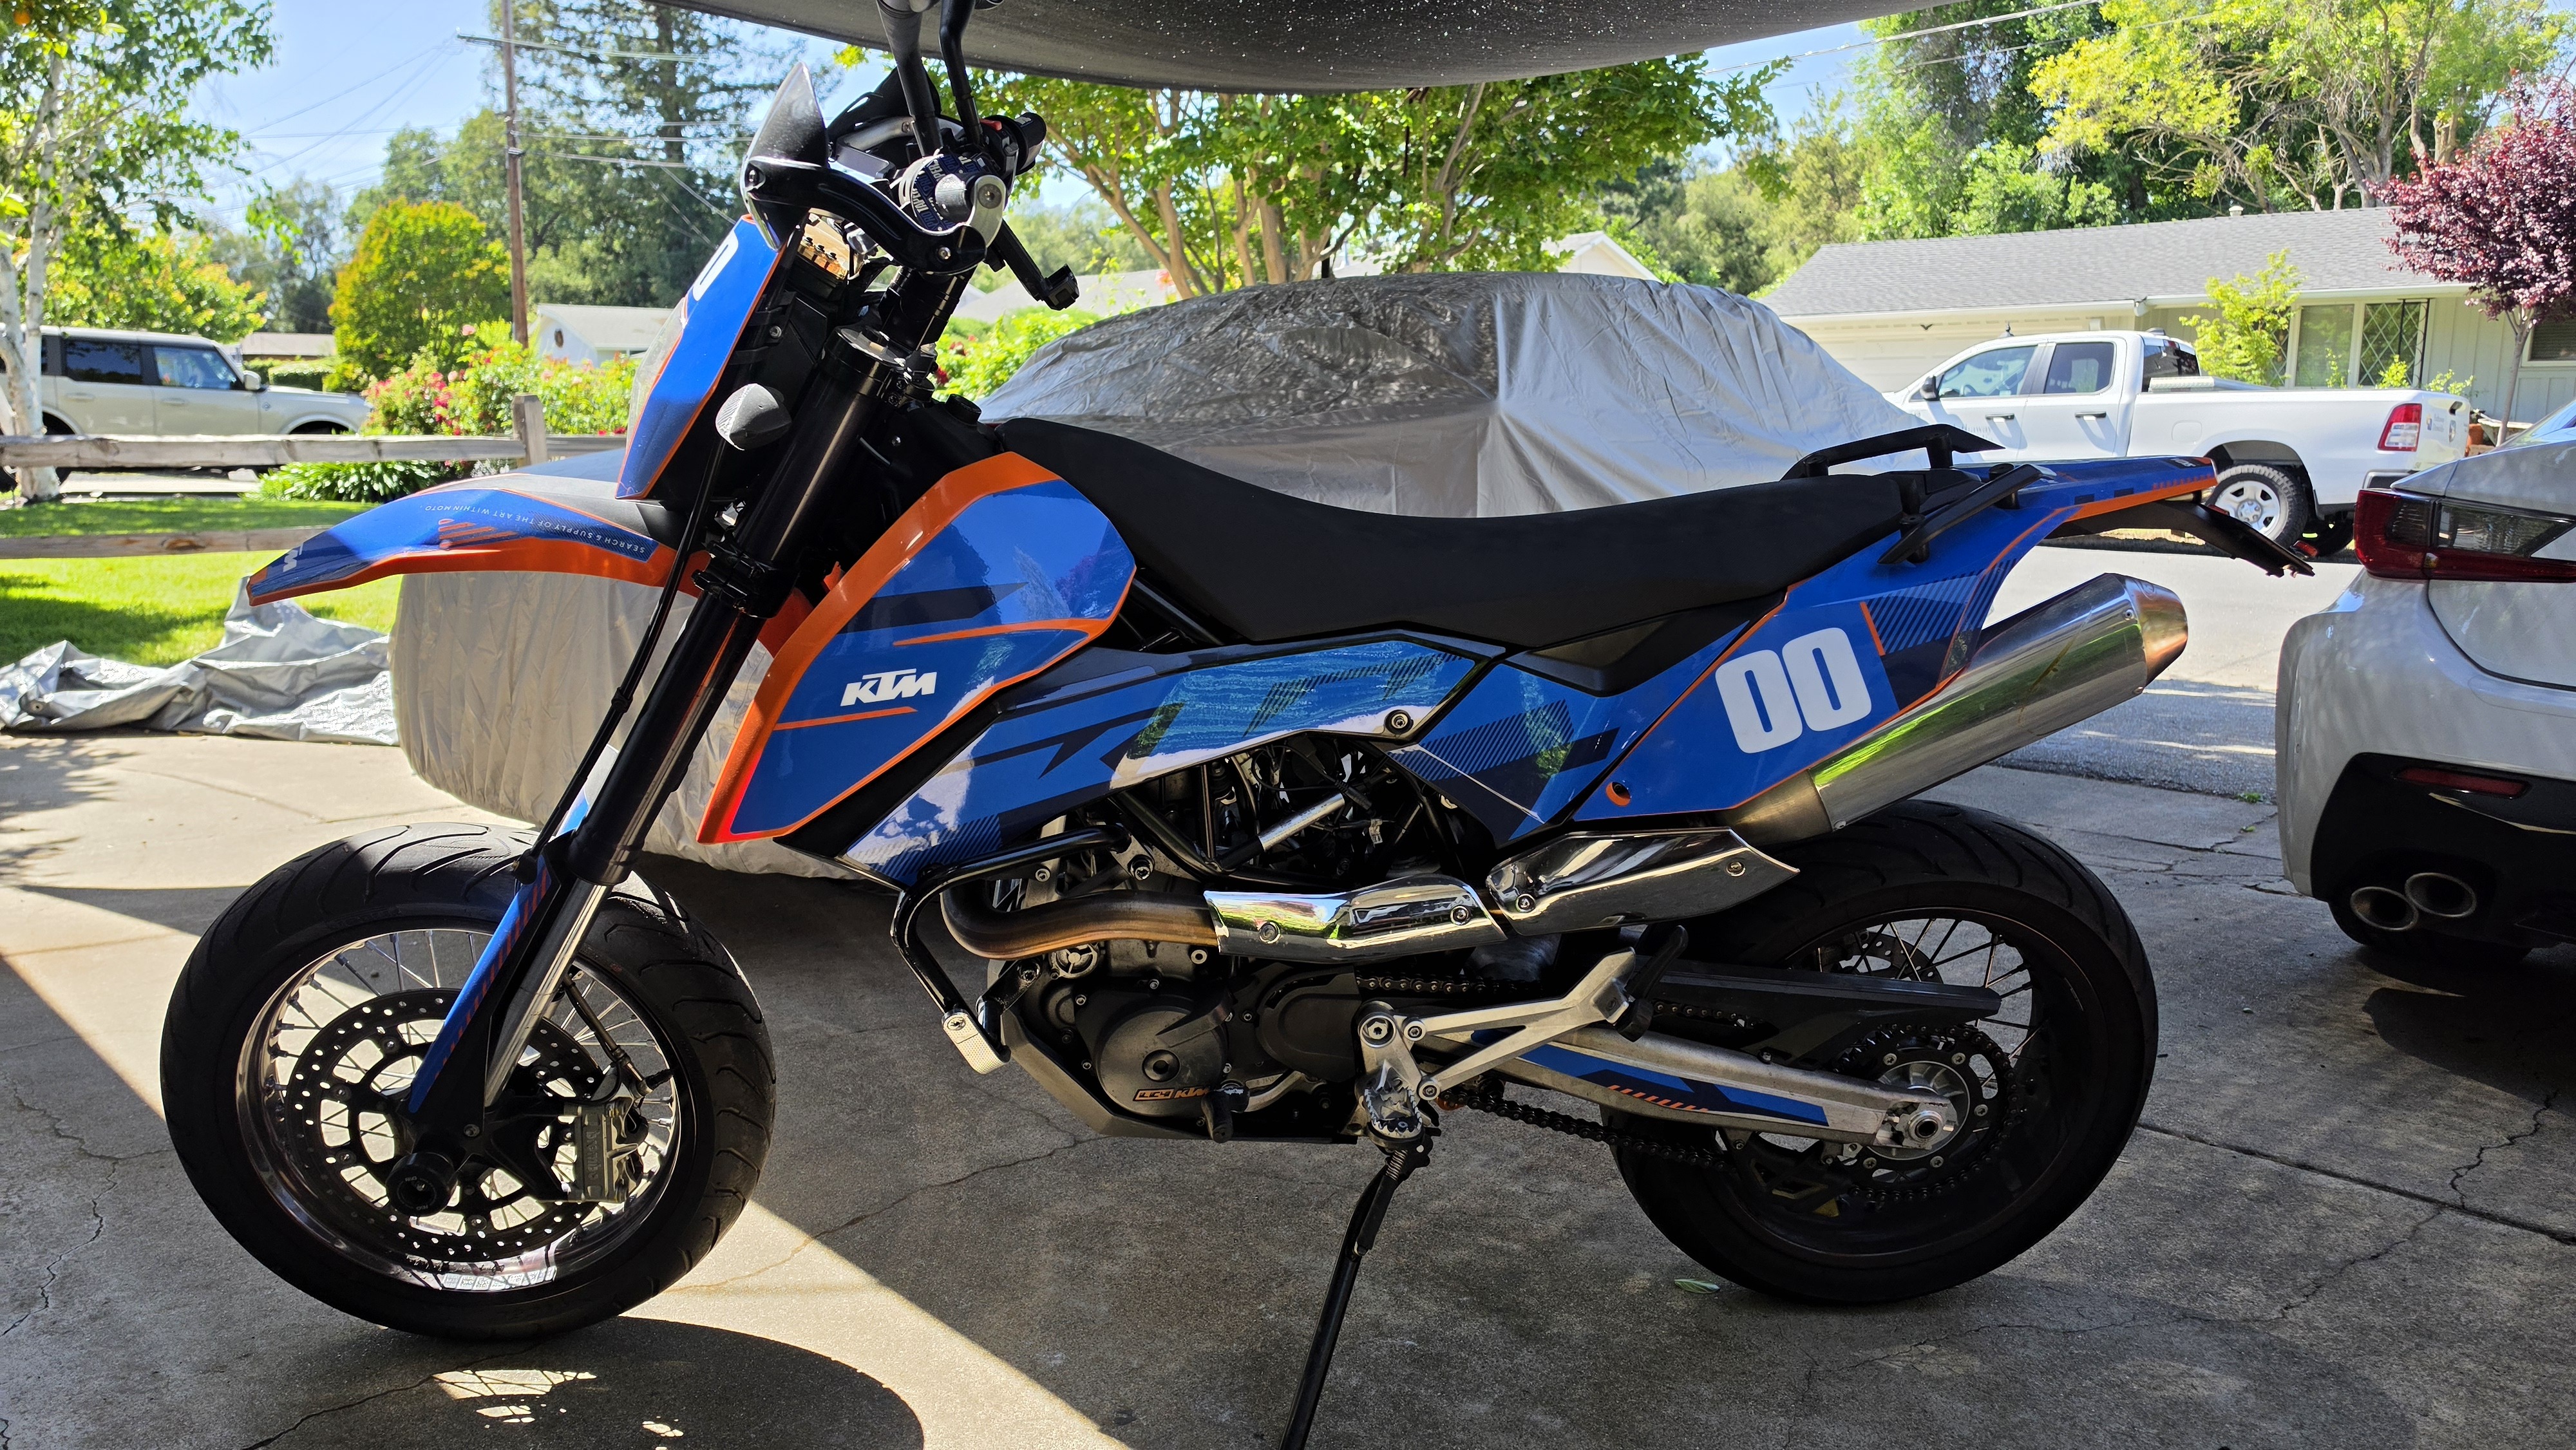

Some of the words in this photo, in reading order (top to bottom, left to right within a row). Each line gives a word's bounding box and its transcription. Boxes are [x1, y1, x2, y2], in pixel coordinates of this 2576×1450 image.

[453, 505, 490, 515] WITHIN
[493, 510, 513, 519] ART
[515, 514, 535, 525] THE
[537, 520, 552, 528] OF
[554, 523, 593, 539] SUPPLY
[604, 537, 645, 554] SEARCH
[840, 668, 937, 706] KTM
[1716, 628, 1872, 753] 00
[586, 1131, 600, 1180] brembo
